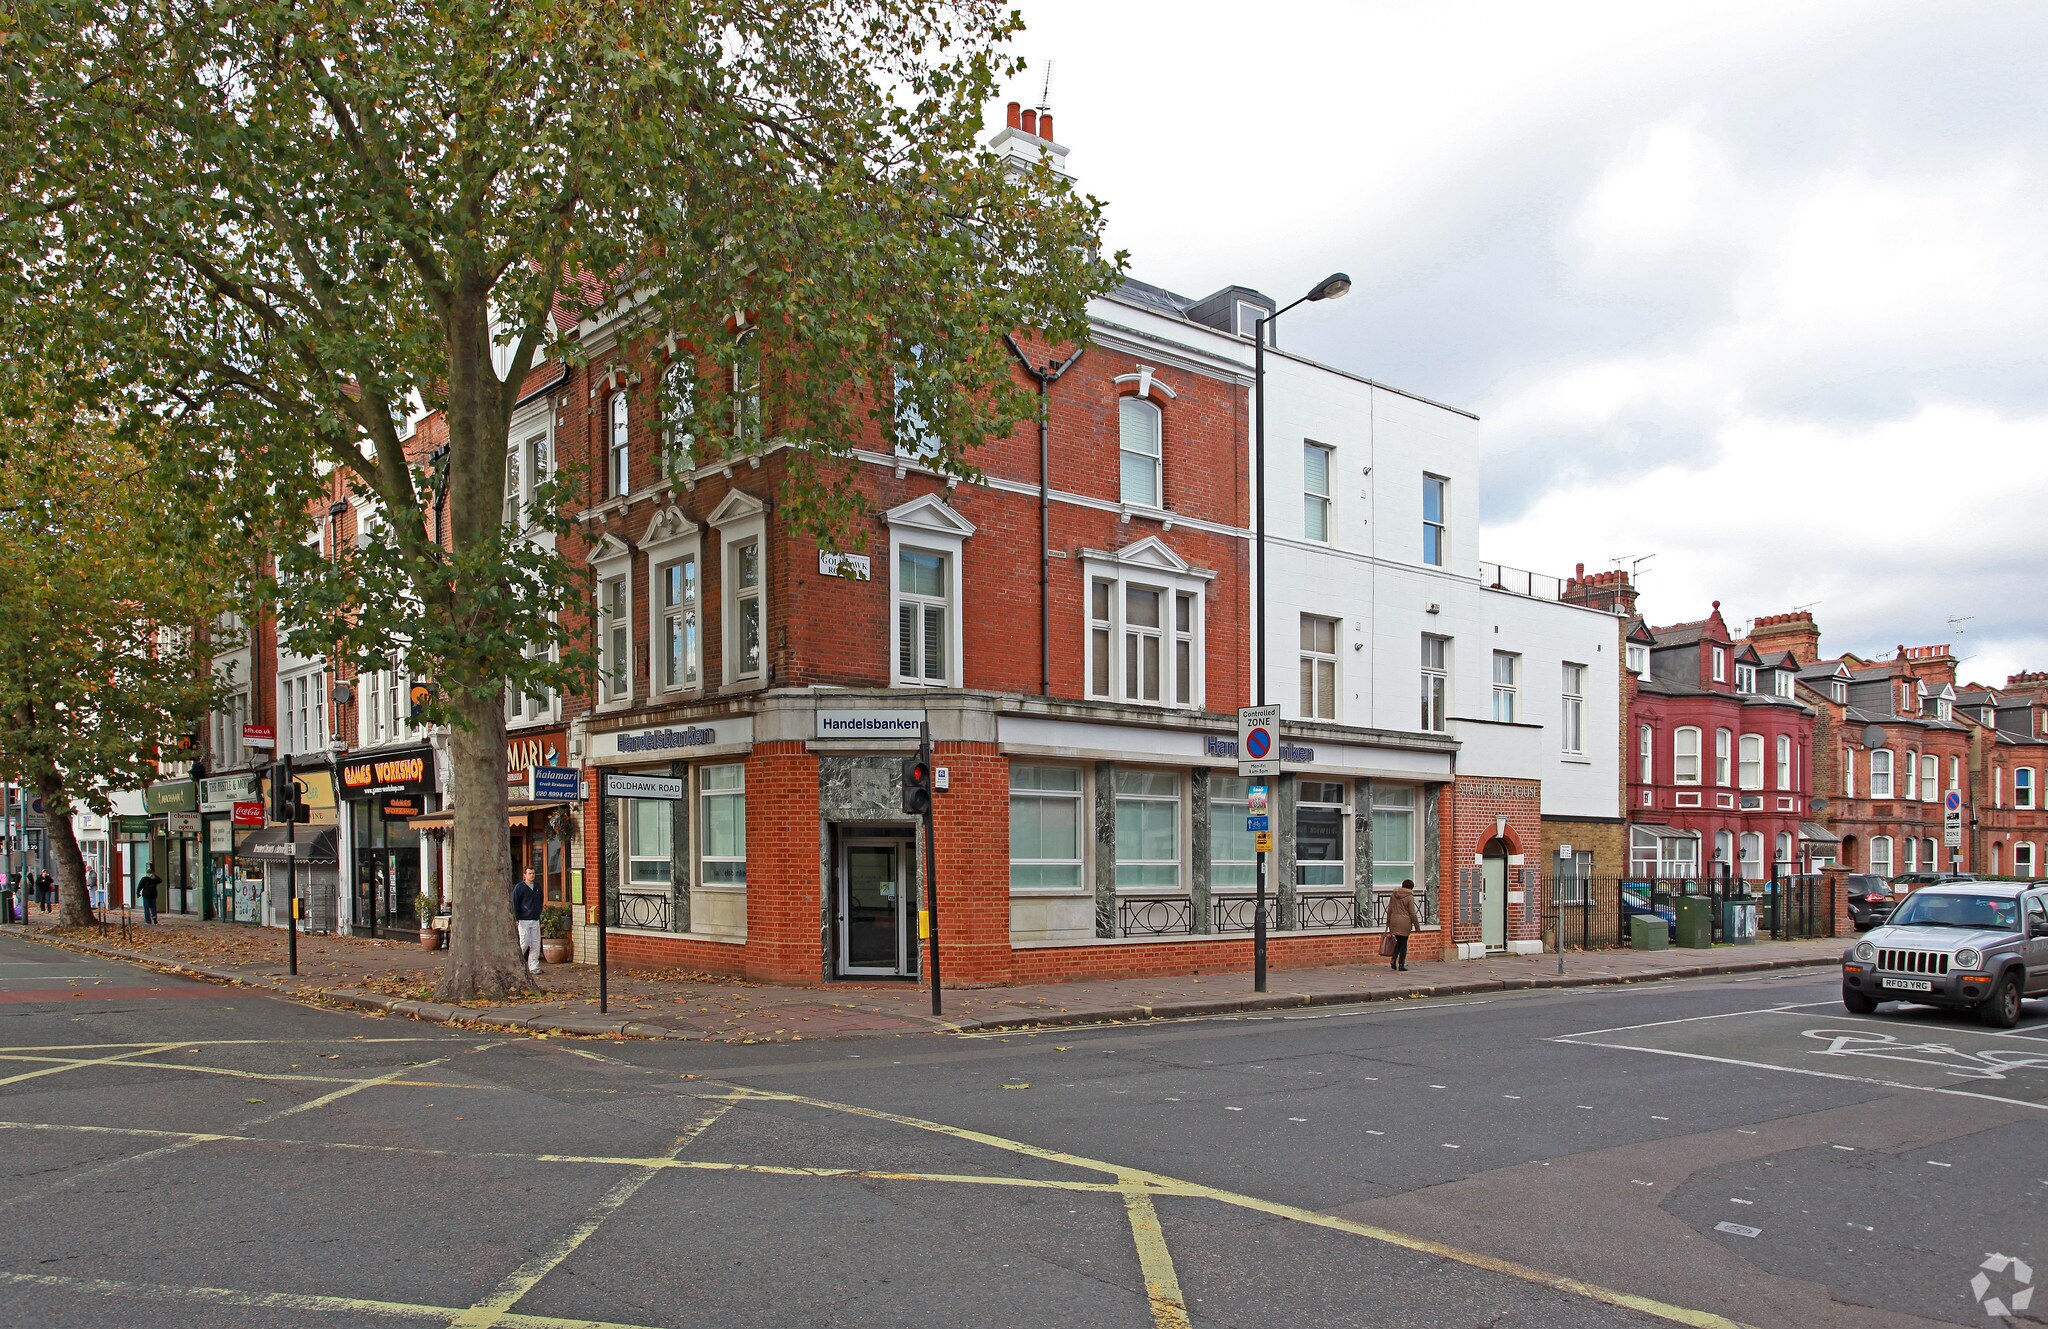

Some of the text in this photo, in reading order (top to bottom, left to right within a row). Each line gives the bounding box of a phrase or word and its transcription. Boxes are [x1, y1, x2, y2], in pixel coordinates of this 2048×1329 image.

[822, 556, 868, 570] GOLAWK
[1243, 709, 1276, 718] Controlled
[823, 718, 919, 729] Handelsbanken
[1247, 717, 1270, 726] ZONE
[244, 727, 271, 735] kfh.co.uk
[617, 726, 713, 752] Handelsbanken
[507, 739, 543, 772] MARI
[344, 757, 424, 786] GAMES WORKSHOP
[536, 769, 577, 780] Kalamari
[610, 781, 680, 793] GOLDHAWK ROAD
[1460, 783, 1538, 798] STAMFORD HOUSE
[390, 799, 411, 807] GAMES
[384, 806, 419, 816] WORKSHOP
[1886, 979, 1928, 990] RF03 YRG
